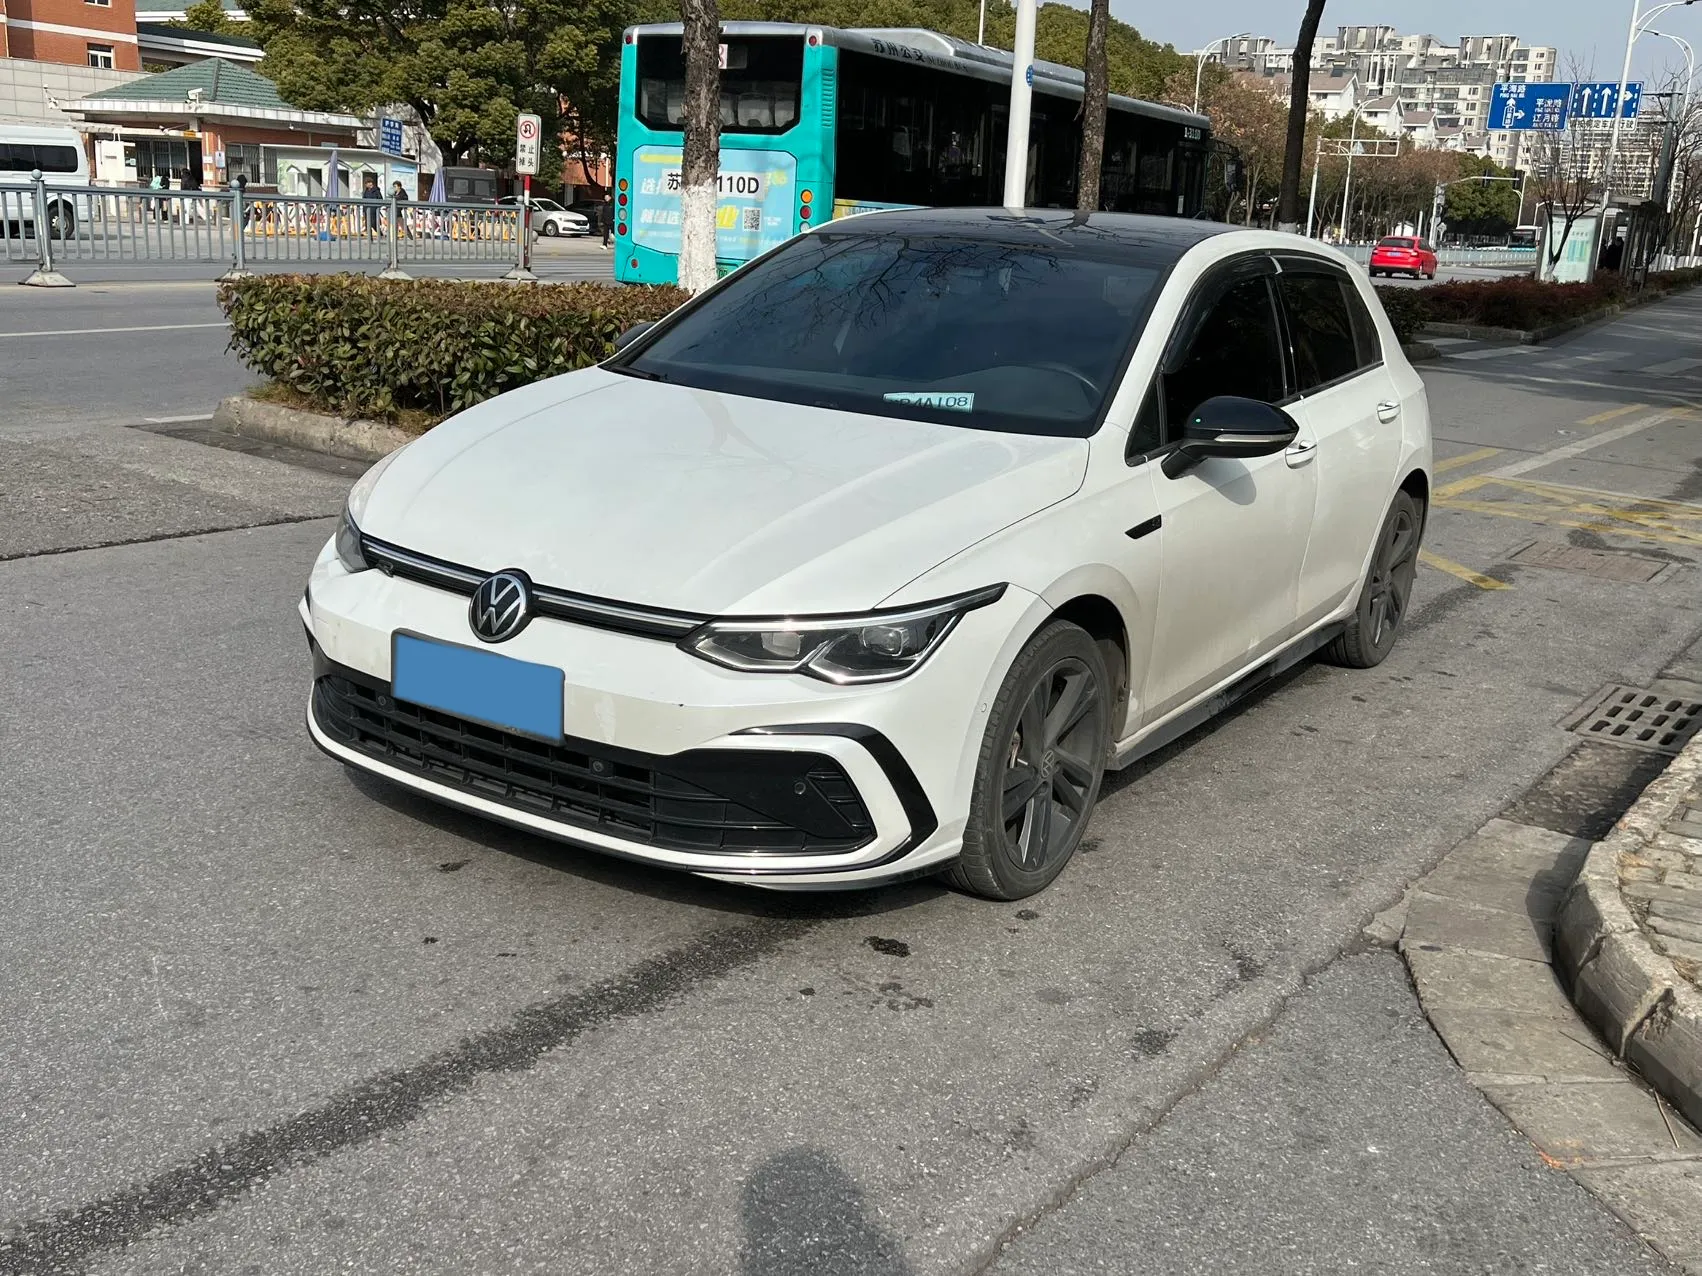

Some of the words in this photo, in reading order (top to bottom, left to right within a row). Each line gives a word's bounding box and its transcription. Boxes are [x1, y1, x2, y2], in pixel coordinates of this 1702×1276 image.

[871, 38, 924, 62] 苏州公交
[1500, 84, 1526, 93] 平海路
[520, 143, 534, 154] 禁止
